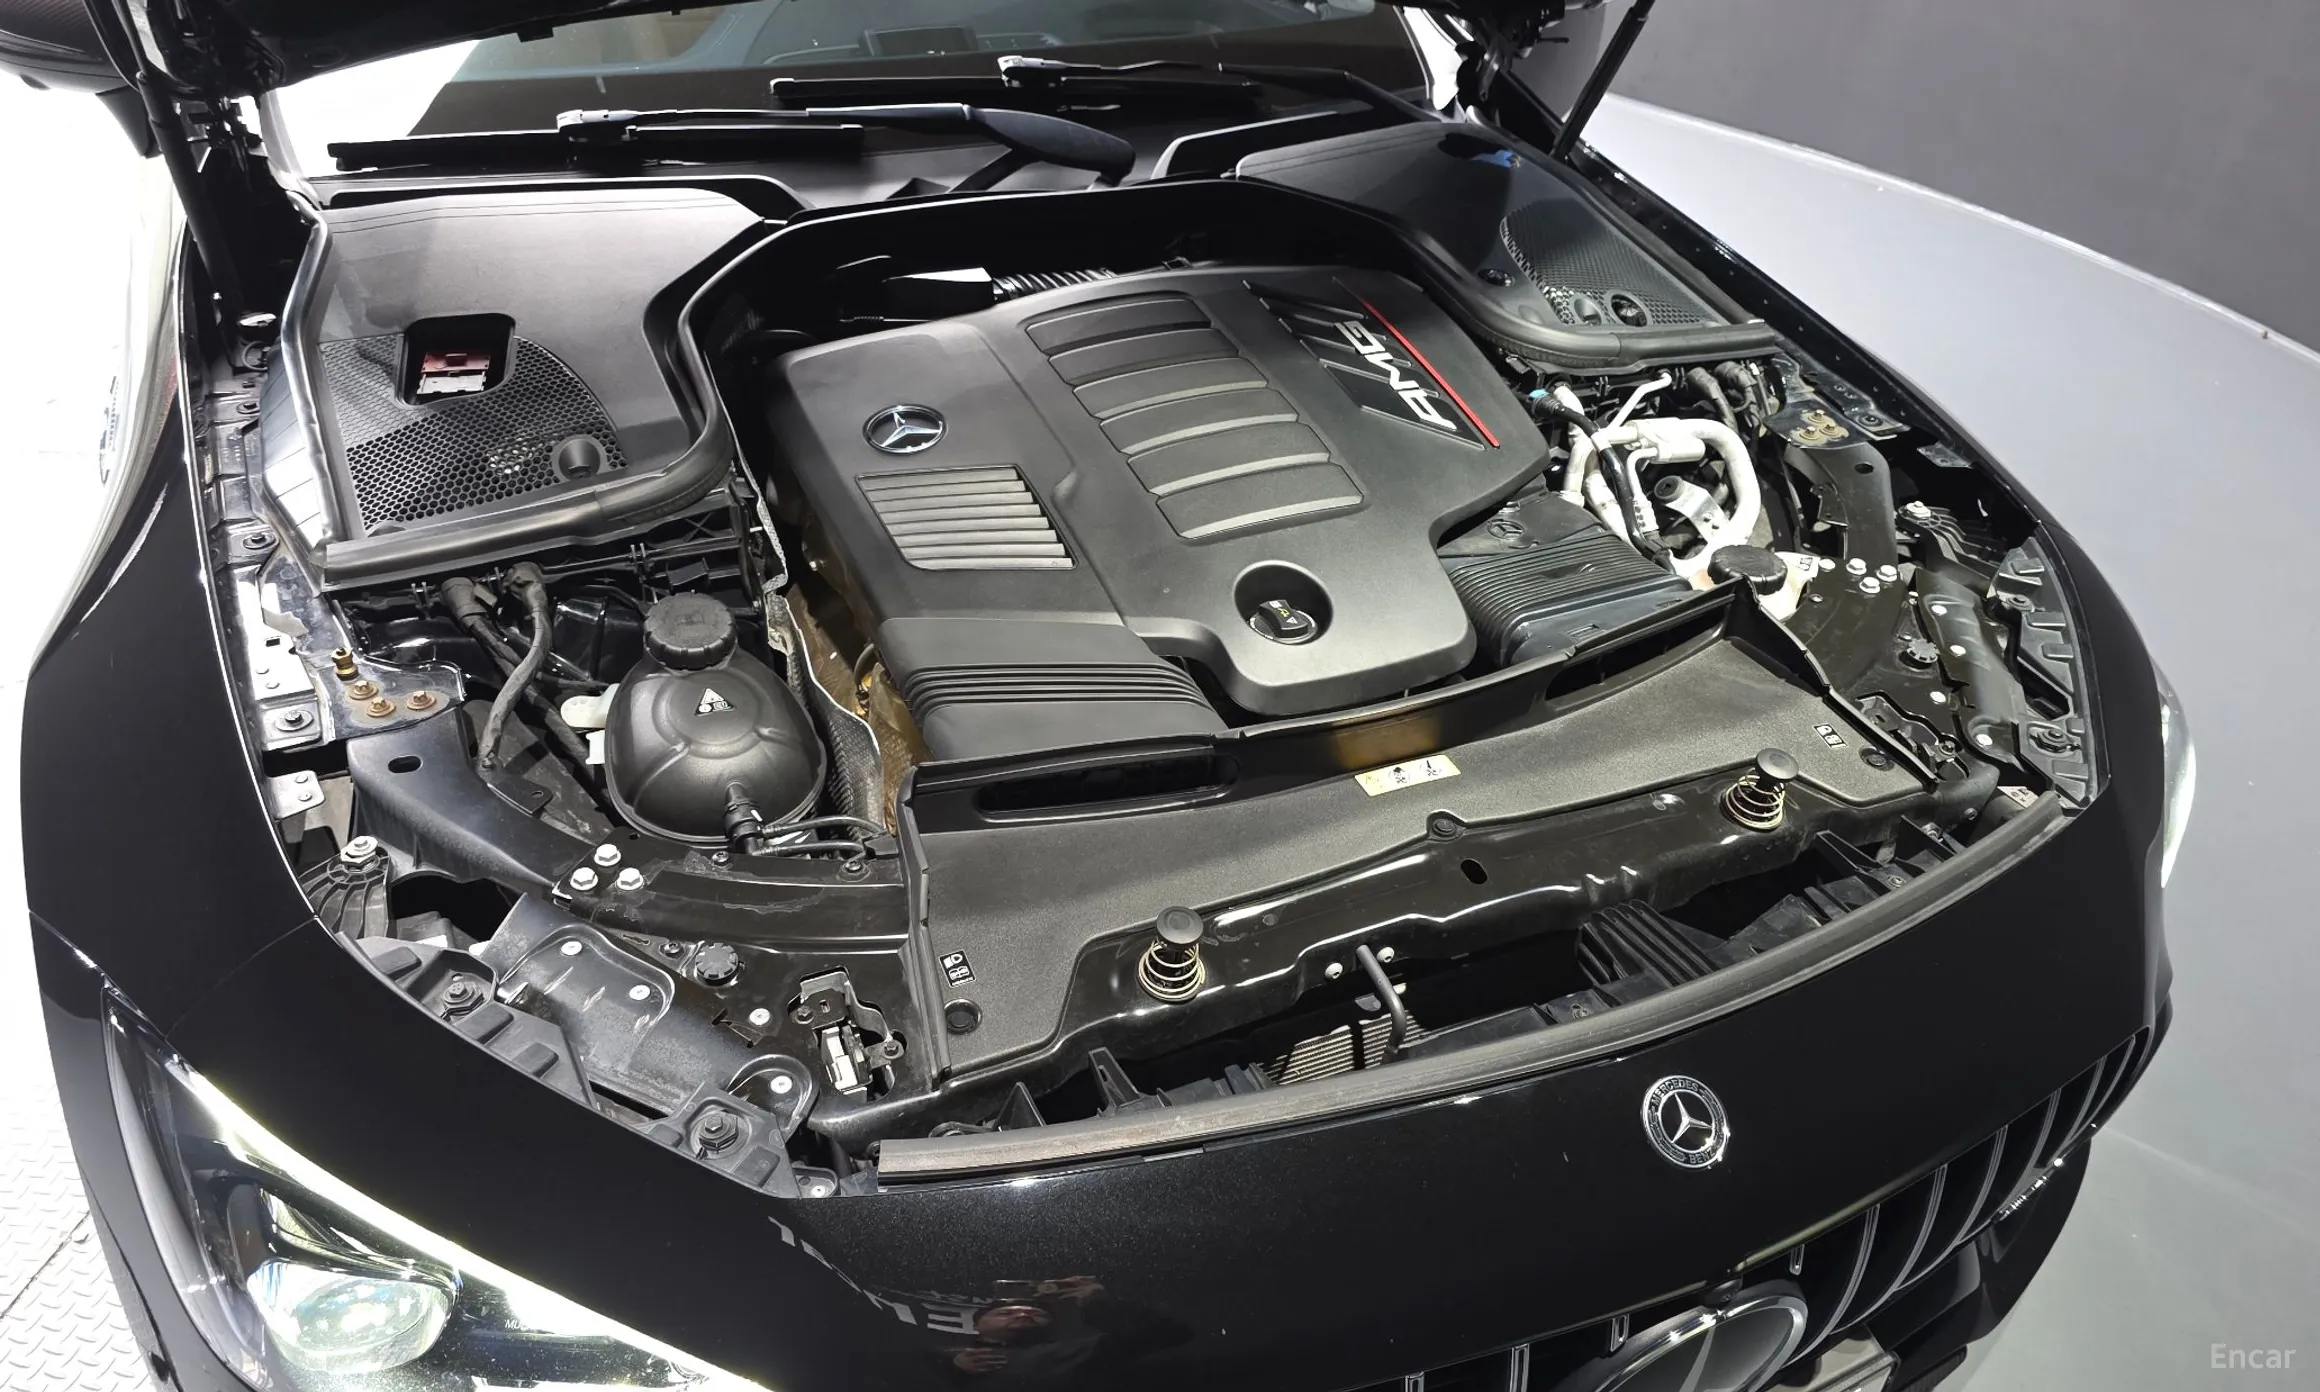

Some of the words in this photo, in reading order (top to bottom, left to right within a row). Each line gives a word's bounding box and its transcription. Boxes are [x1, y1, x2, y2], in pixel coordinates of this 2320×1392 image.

[1334, 320, 1458, 431] AMG
[1651, 1079, 1699, 1106] MERCEDES
[1689, 1147, 1716, 1164] BENZ
